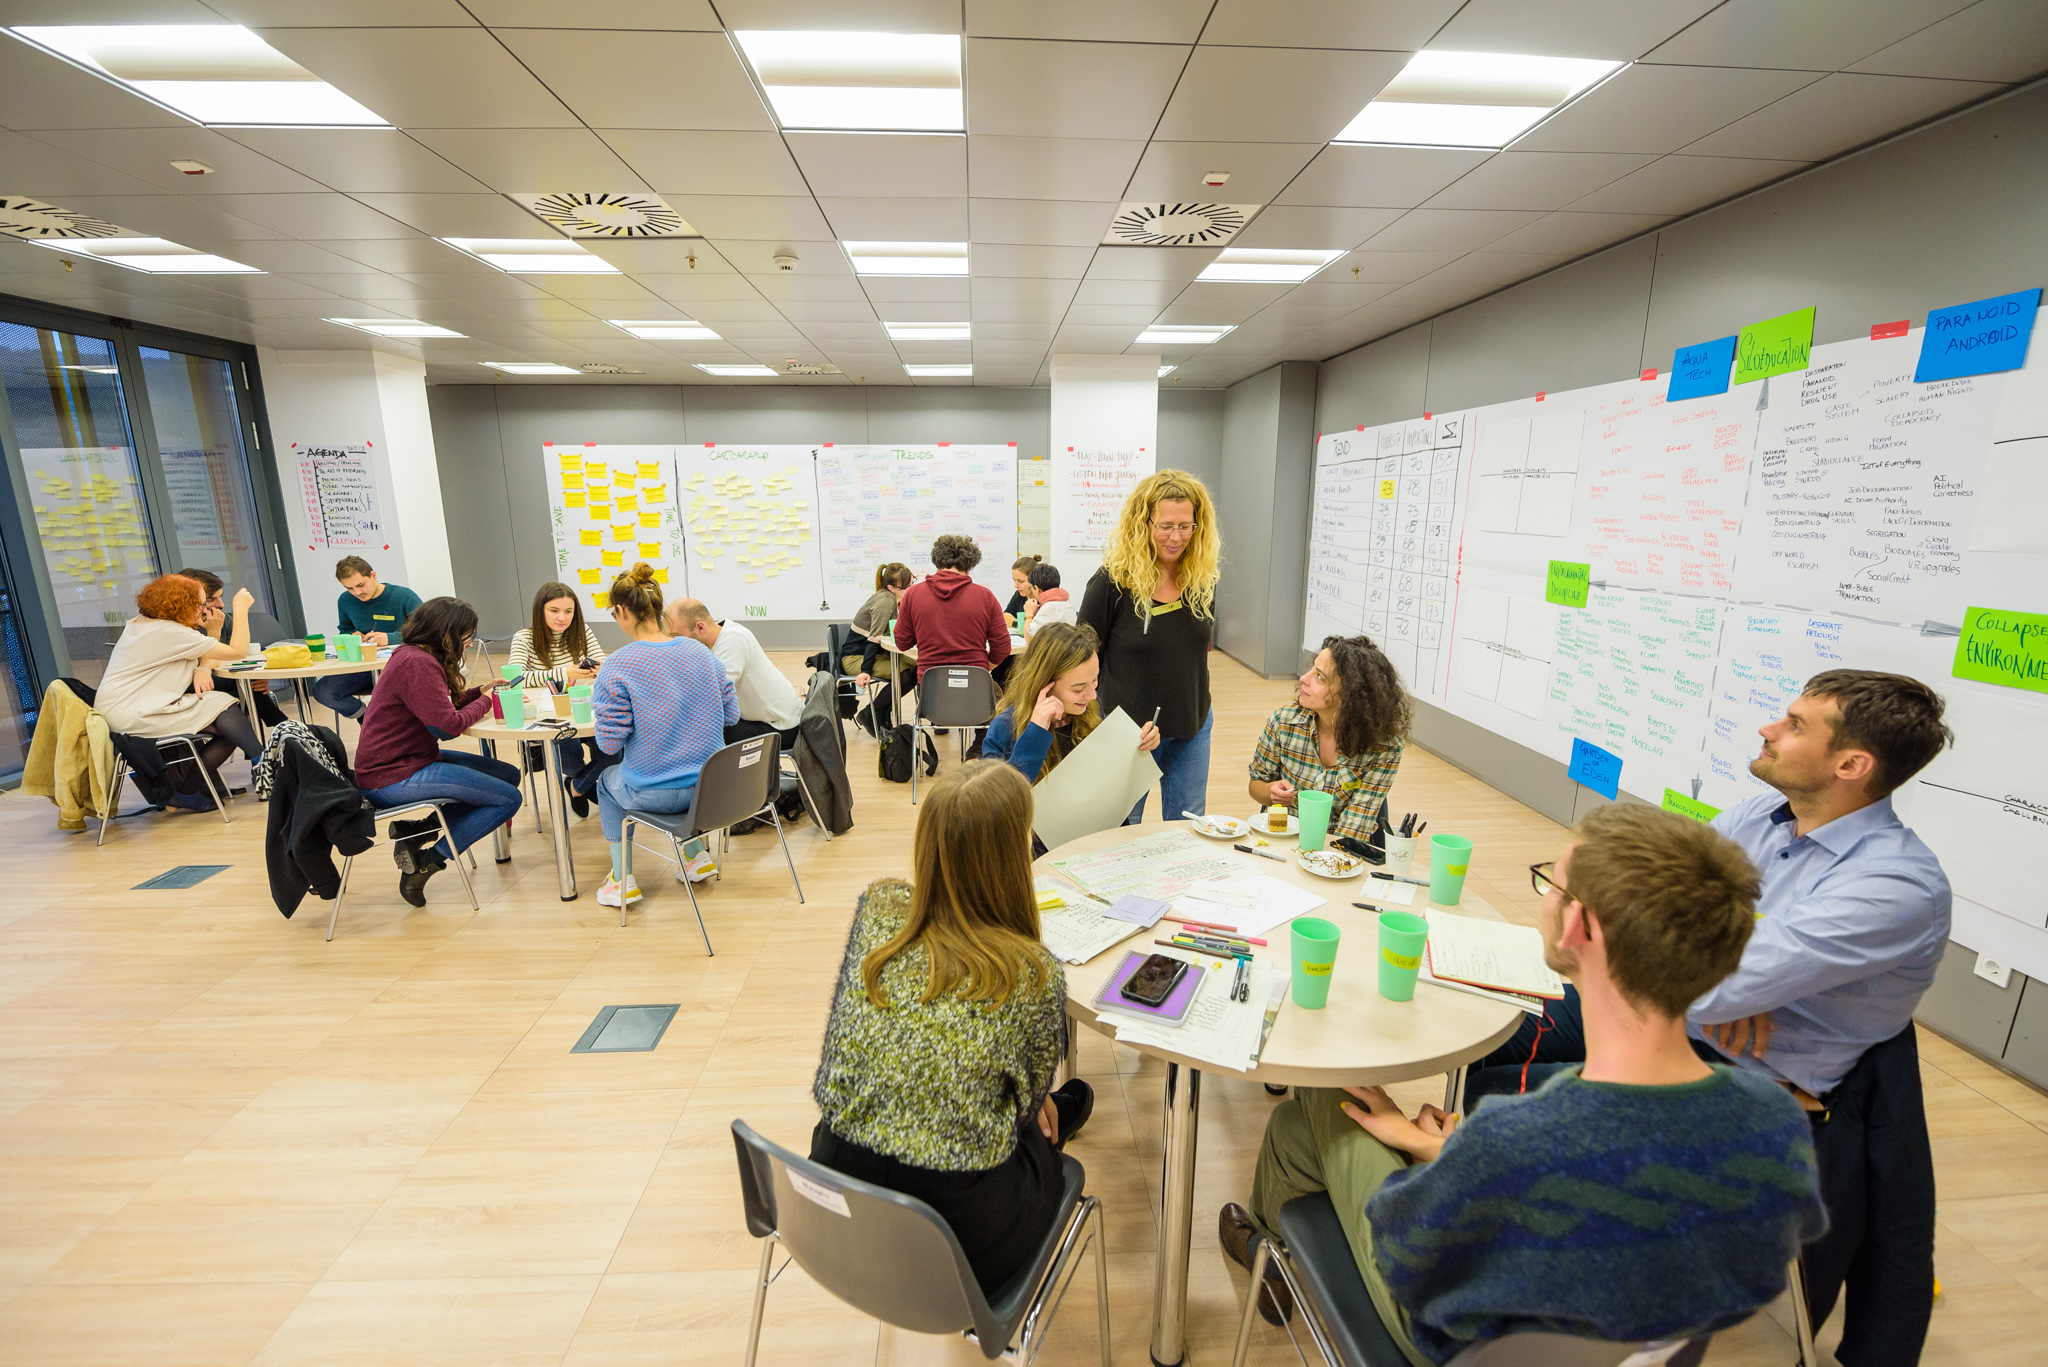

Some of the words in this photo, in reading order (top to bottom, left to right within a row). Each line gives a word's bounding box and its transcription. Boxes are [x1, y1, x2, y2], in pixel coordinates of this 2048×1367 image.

[1684, 370, 1712, 380] TECH
[307, 448, 347, 459] AGENDA
[890, 450, 934, 461] TRENDS
[745, 605, 767, 617] NOW
[2003, 805, 2048, 825] CHALLEN
